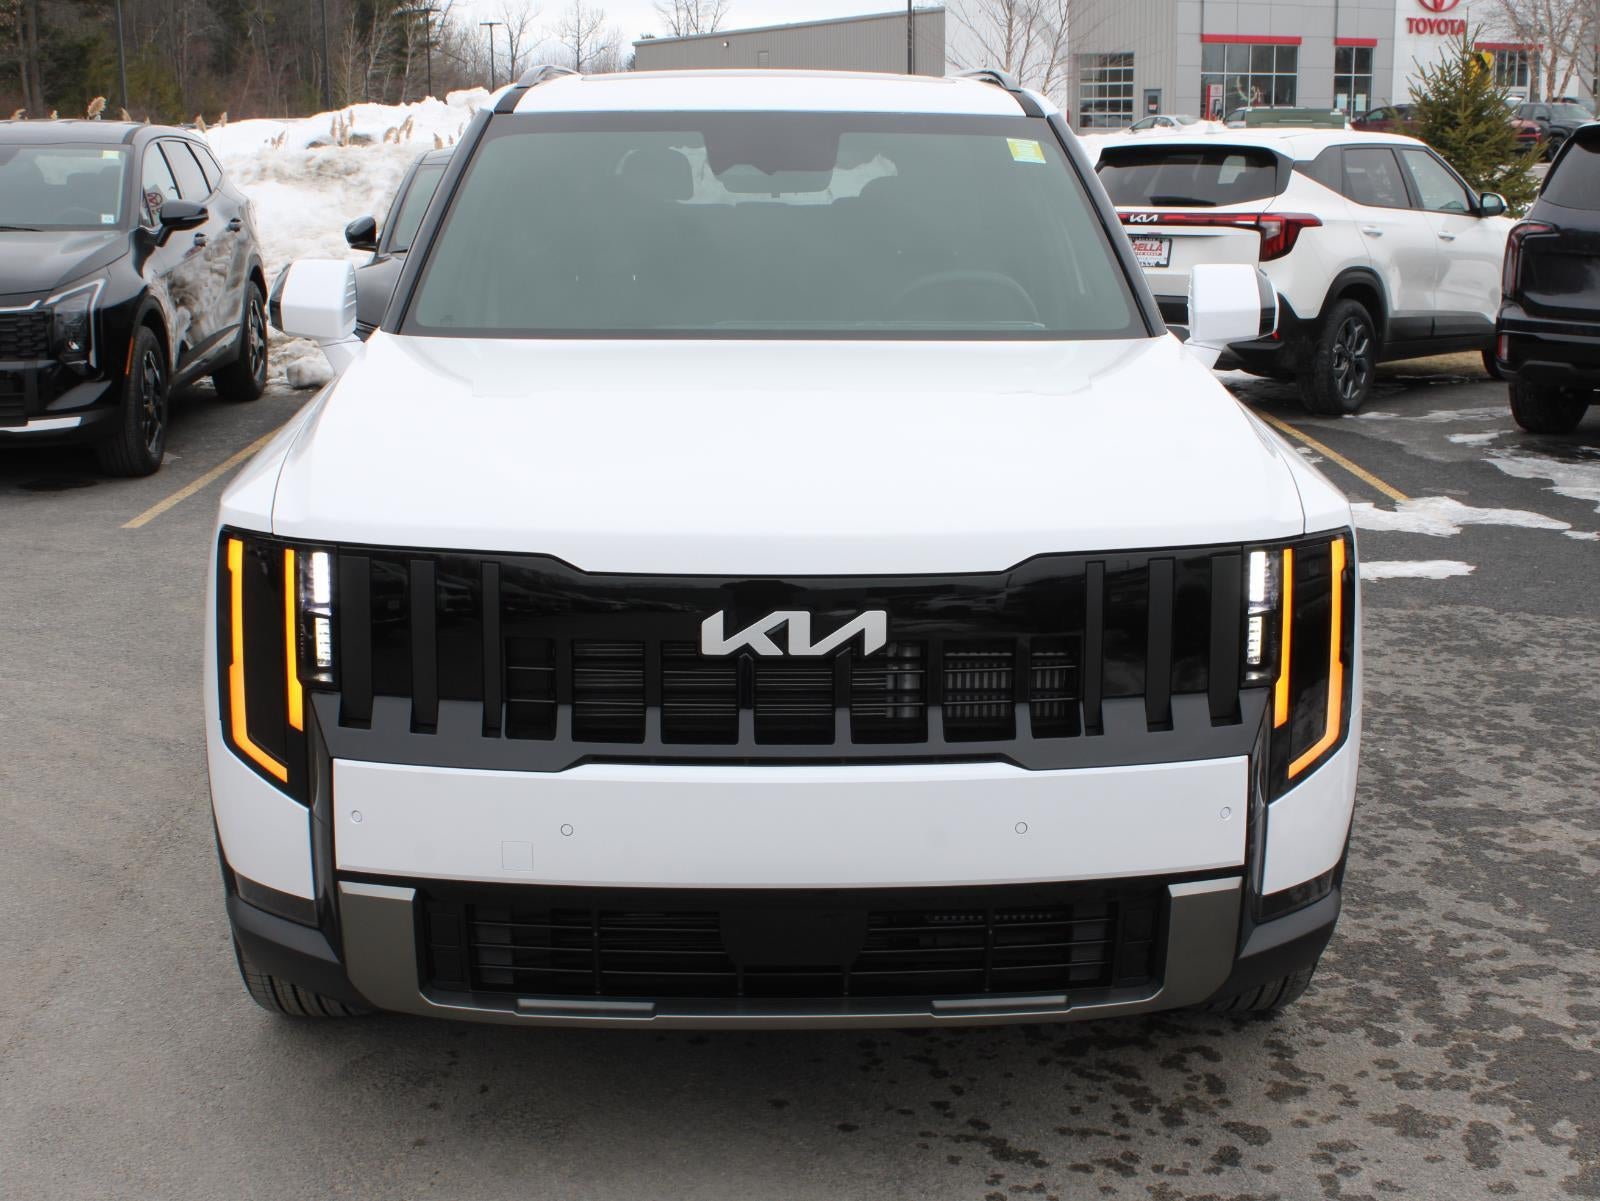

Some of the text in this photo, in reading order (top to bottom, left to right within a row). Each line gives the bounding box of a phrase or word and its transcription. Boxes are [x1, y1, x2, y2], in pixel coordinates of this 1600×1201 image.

[1407, 17, 1466, 35] TOYOTA
[1130, 213, 1158, 222] KIA
[702, 610, 887, 656] KIA
